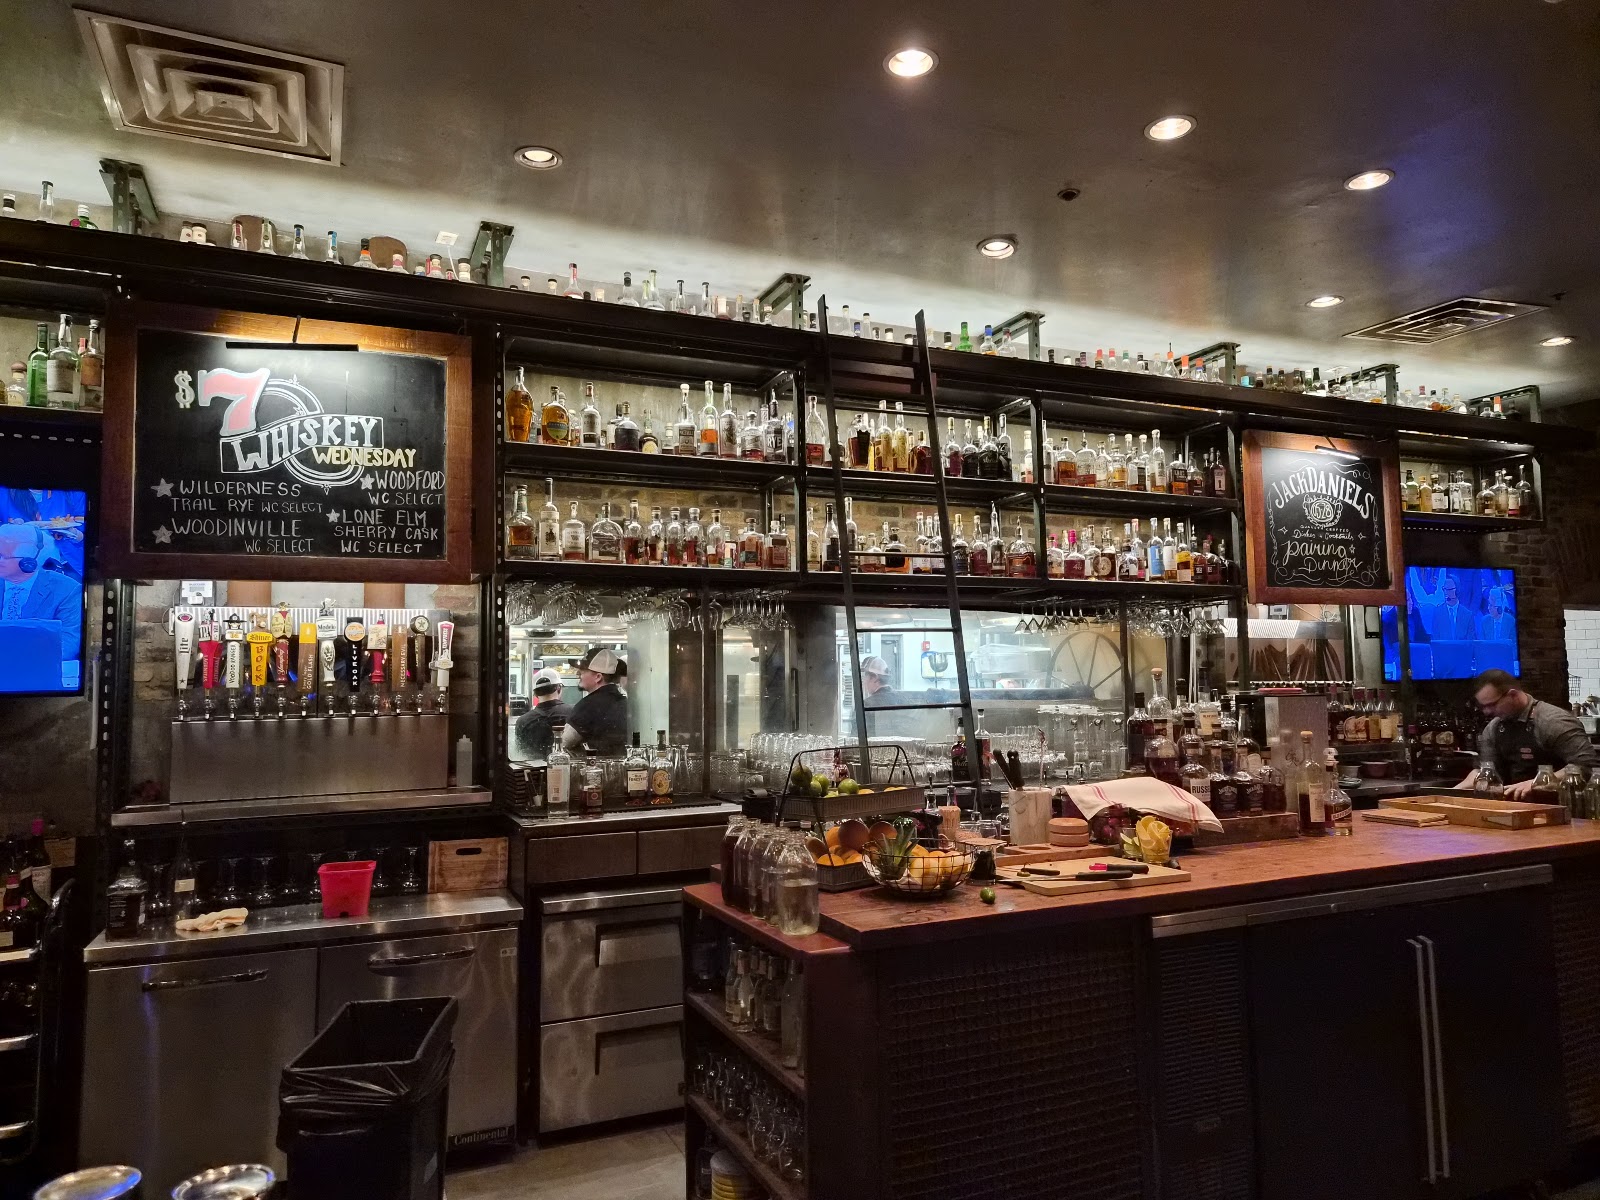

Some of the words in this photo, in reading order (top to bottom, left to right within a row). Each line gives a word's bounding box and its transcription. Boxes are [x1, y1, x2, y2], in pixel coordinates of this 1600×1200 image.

[231, 416, 378, 472] WHISKEY
[767, 436, 783, 449] RYE
[312, 447, 417, 469] WEDNESDAY
[180, 481, 302, 497] WILDERNESS
[375, 470, 446, 491] WOODFORD
[172, 499, 217, 512] TRAIL
[228, 499, 255, 512] RYE
[261, 501, 280, 514] WC
[281, 501, 323, 514] SELECT
[368, 492, 391, 506] WC
[394, 492, 444, 506] SELECT
[342, 509, 385, 526] LONE
[395, 510, 427, 528] ELM
[171, 518, 302, 537] WOODINVILLE
[334, 525, 396, 541] SHERRY
[405, 528, 439, 541] CASK
[245, 539, 262, 554] WC
[265, 538, 315, 554] SELECT
[341, 540, 360, 554] WC
[368, 541, 423, 554] SELECT
[255, 646, 264, 682] BOCK
[454, 1126, 510, 1146] Continental
